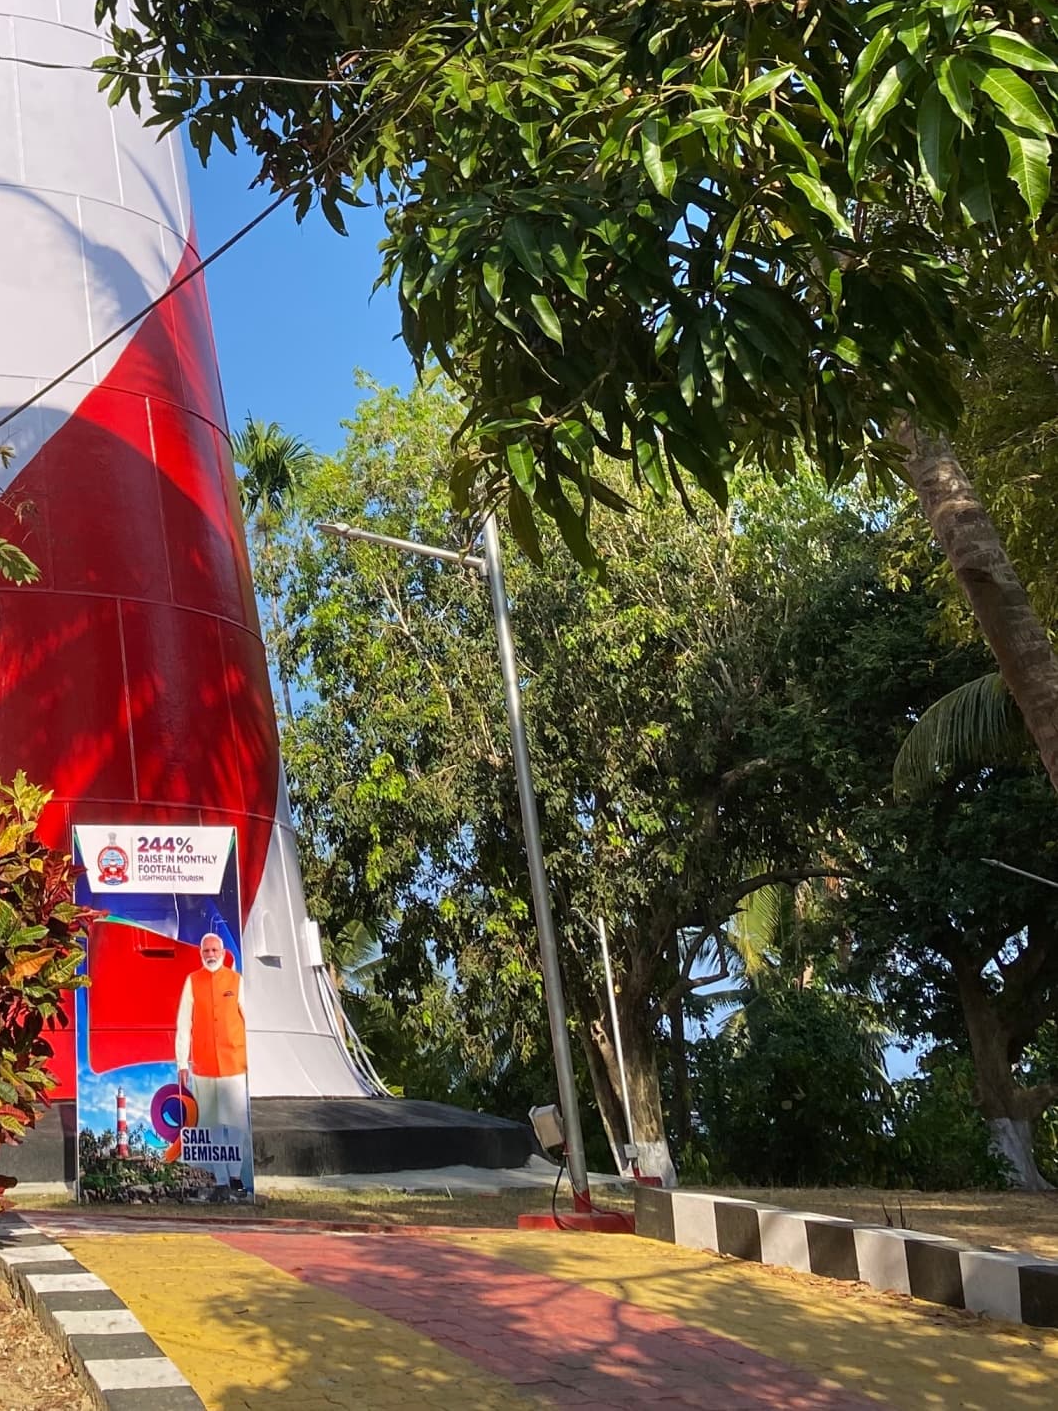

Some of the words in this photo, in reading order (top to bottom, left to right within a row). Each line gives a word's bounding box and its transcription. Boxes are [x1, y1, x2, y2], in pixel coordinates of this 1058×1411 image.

[137, 836, 193, 854] 244%
[138, 854, 163, 864] RAISE
[165, 854, 174, 864] IN
[177, 854, 217, 865] MONTHLY
[138, 864, 183, 874] FOOTFALL
[182, 1129, 212, 1144] SAAL
[183, 1145, 242, 1162] BEMISAAL
